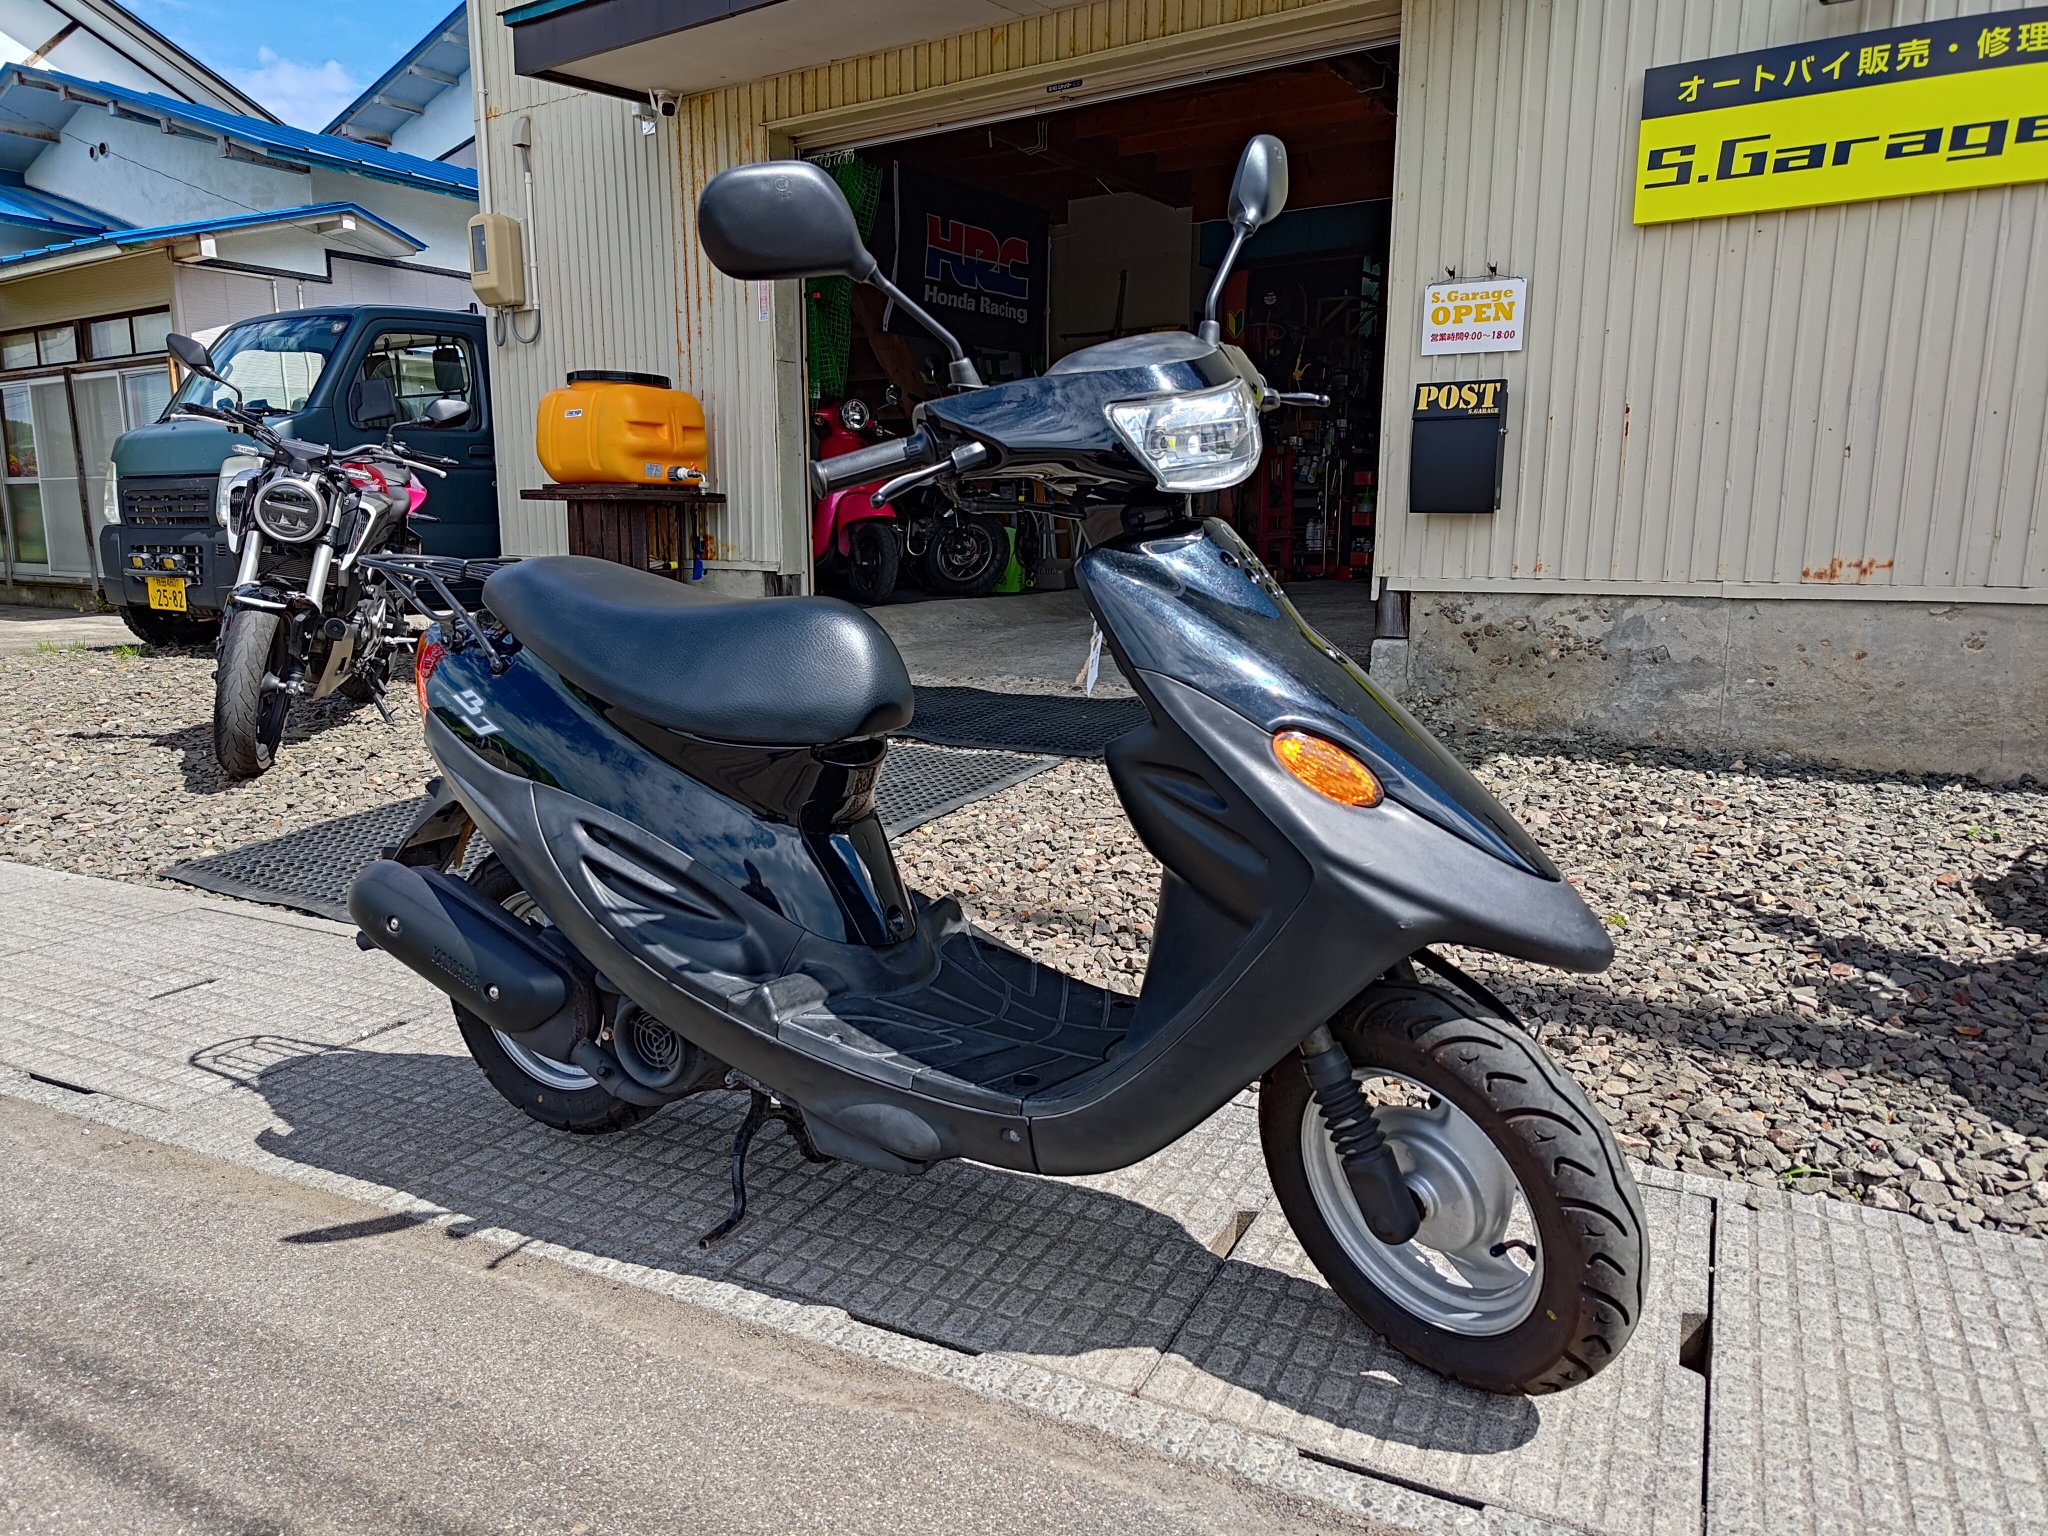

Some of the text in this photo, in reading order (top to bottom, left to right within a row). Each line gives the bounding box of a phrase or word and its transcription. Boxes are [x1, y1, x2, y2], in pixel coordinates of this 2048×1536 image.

[1643, 114, 2048, 190] S.Garage
[924, 212, 1029, 300] HRC
[923, 284, 1028, 324] Honda Racing
[1431, 288, 1514, 304] S.Garage
[1430, 301, 1516, 326] OPEN
[1416, 382, 1502, 411] POST
[1467, 407, 1500, 415] S.GARAGE
[156, 588, 185, 609] 25-82
[430, 944, 480, 992] YAMAHA
